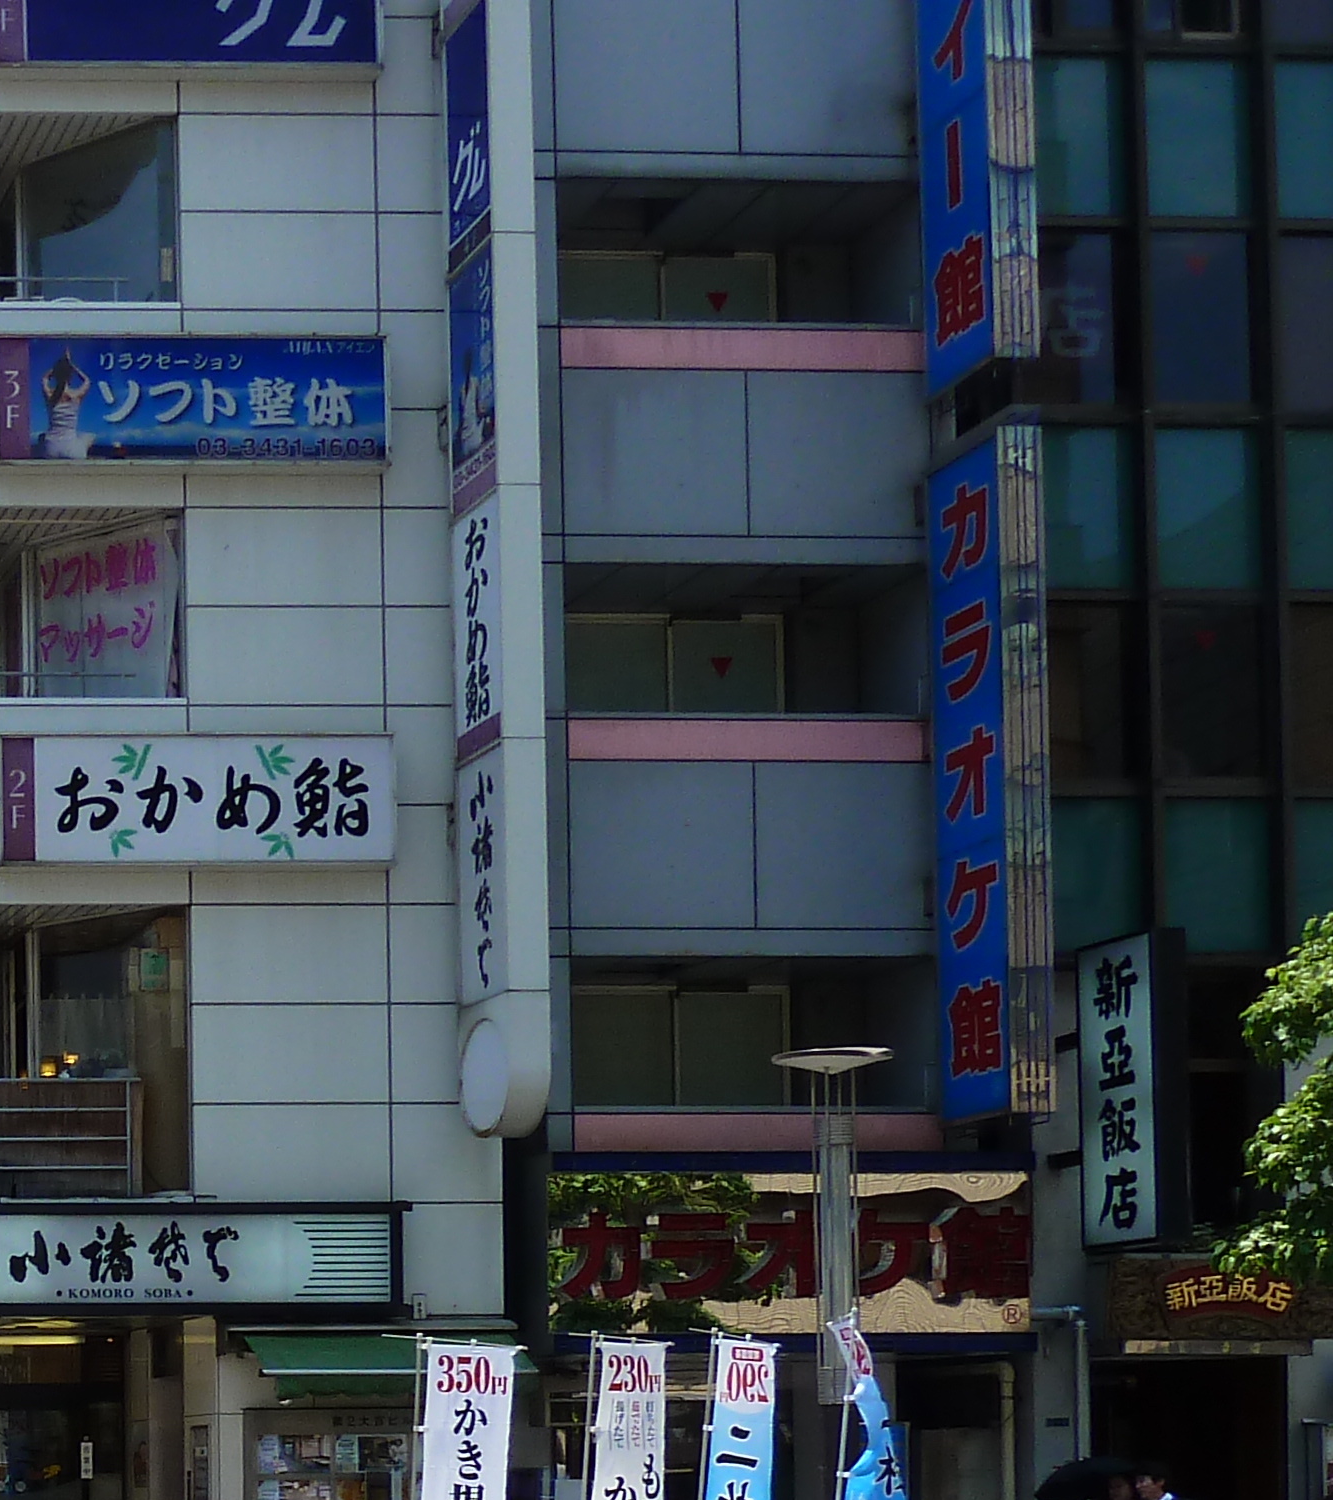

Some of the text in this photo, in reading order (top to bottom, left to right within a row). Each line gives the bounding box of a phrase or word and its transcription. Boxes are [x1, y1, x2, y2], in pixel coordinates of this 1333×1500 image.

[98, 352, 244, 371] リラクゼーション
[2, 370, 24, 429] 3F
[97, 376, 355, 428] ソフト整体
[195, 437, 378, 458] 03-3431-1603
[38, 600, 155, 663] マッサージ
[464, 515, 490, 729] おかめ鮨
[7, 769, 28, 830] 2F
[53, 756, 370, 838] おかめ鮨
[939, 480, 1004, 1080] カラオケ館
[1093, 955, 1141, 1231] 新亞飯店
[557, 1205, 1029, 1301] カラオケ館
[68, 1287, 183, 1299] KOMORO SOBA
[1164, 1274, 1293, 1314] 新亞飯店
[436, 1354, 508, 1395] 350円
[607, 1354, 662, 1393] 230円
